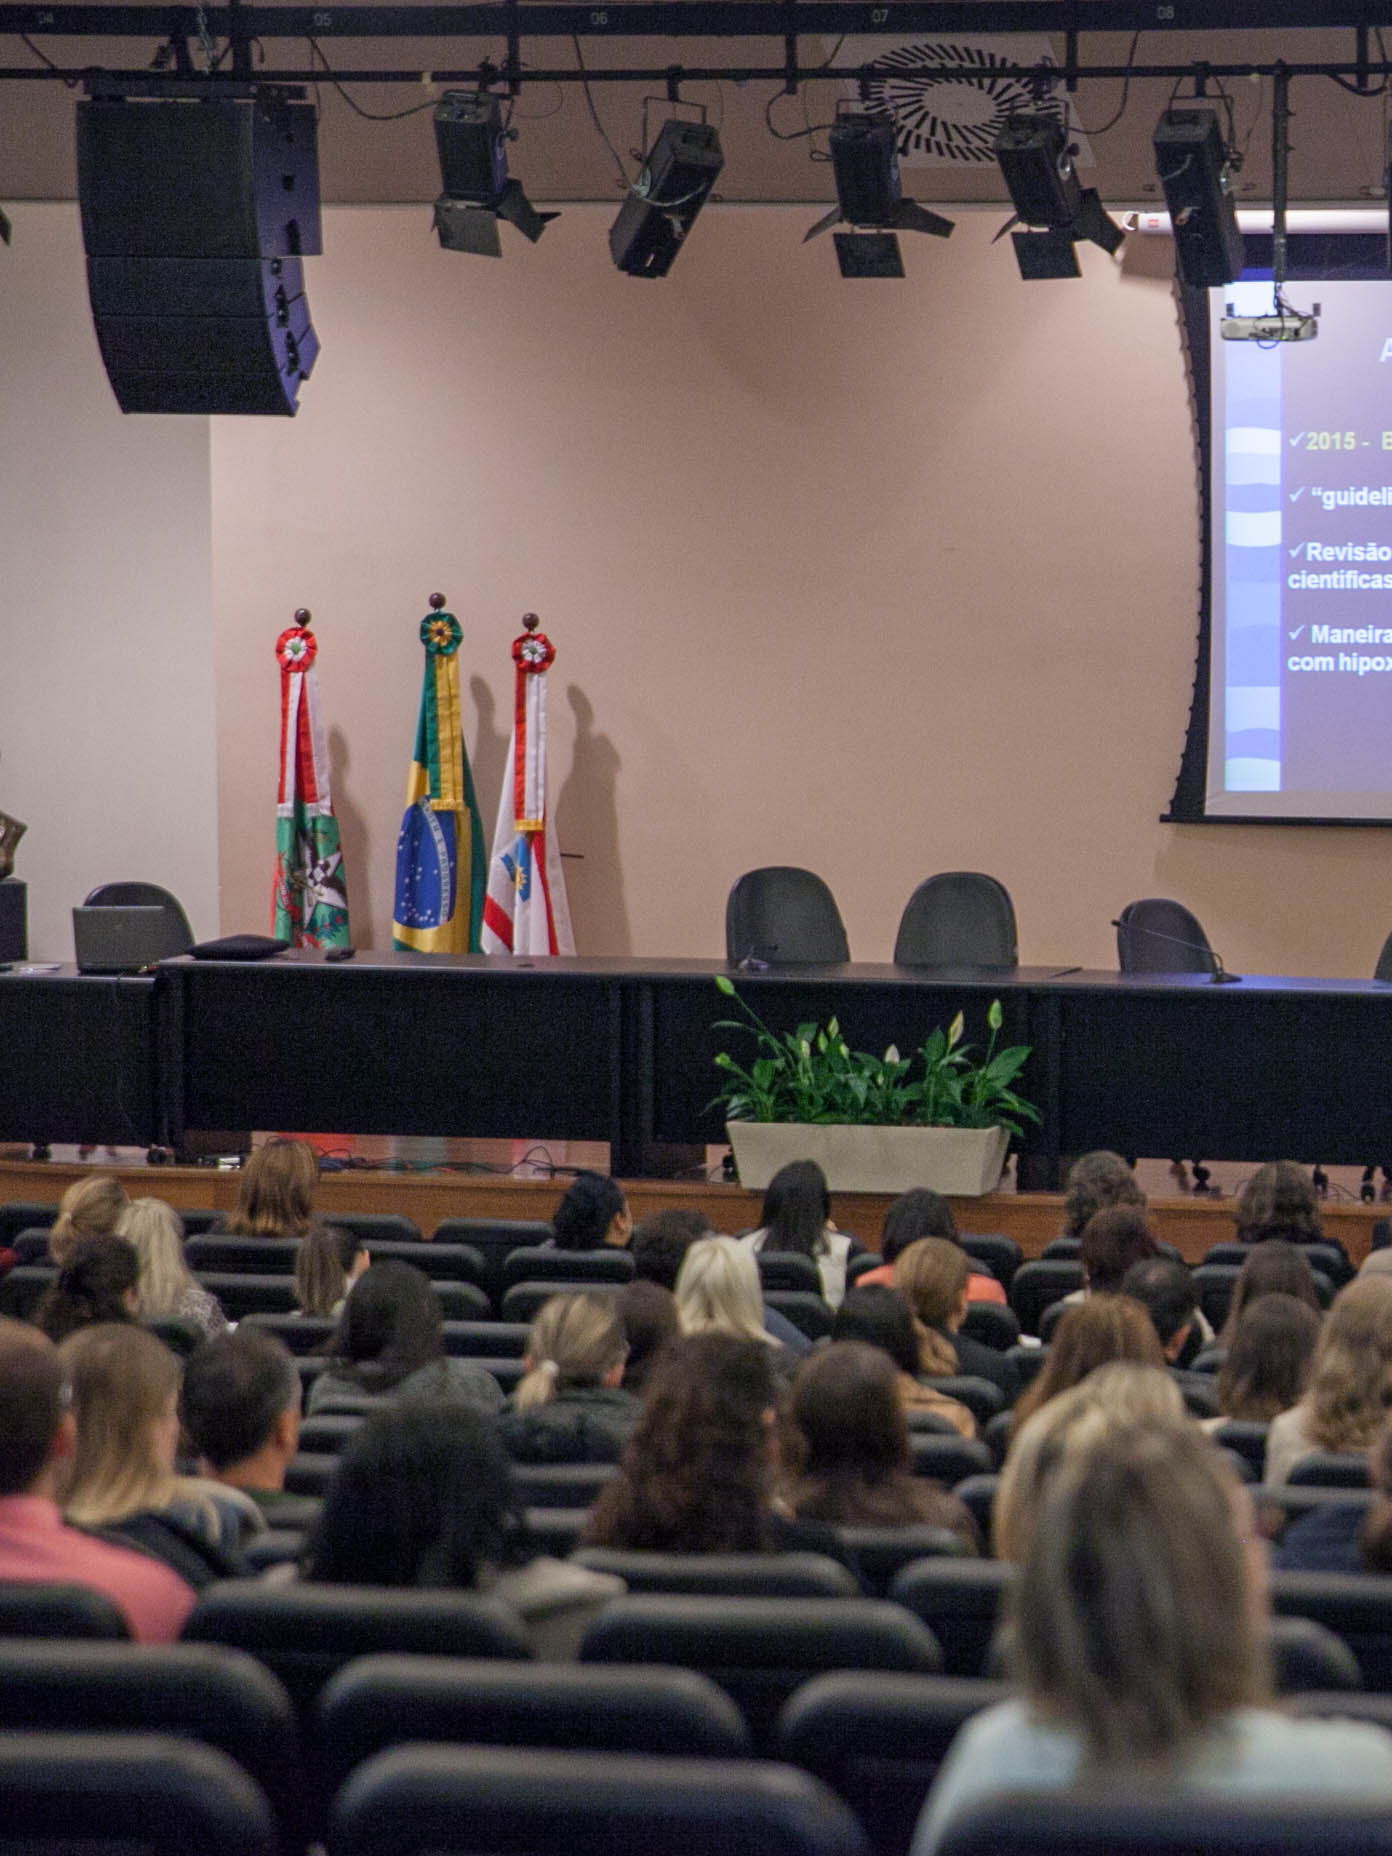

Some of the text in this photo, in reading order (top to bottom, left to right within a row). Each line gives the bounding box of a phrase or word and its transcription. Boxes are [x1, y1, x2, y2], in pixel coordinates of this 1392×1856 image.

[590, 12, 608, 25] 06
[872, 9, 889, 23] 07
[1156, 6, 1175, 19] 08
[1307, 432, 1356, 450] 2015
[1308, 543, 1392, 561] Revisão
[1288, 656, 1335, 671] com
